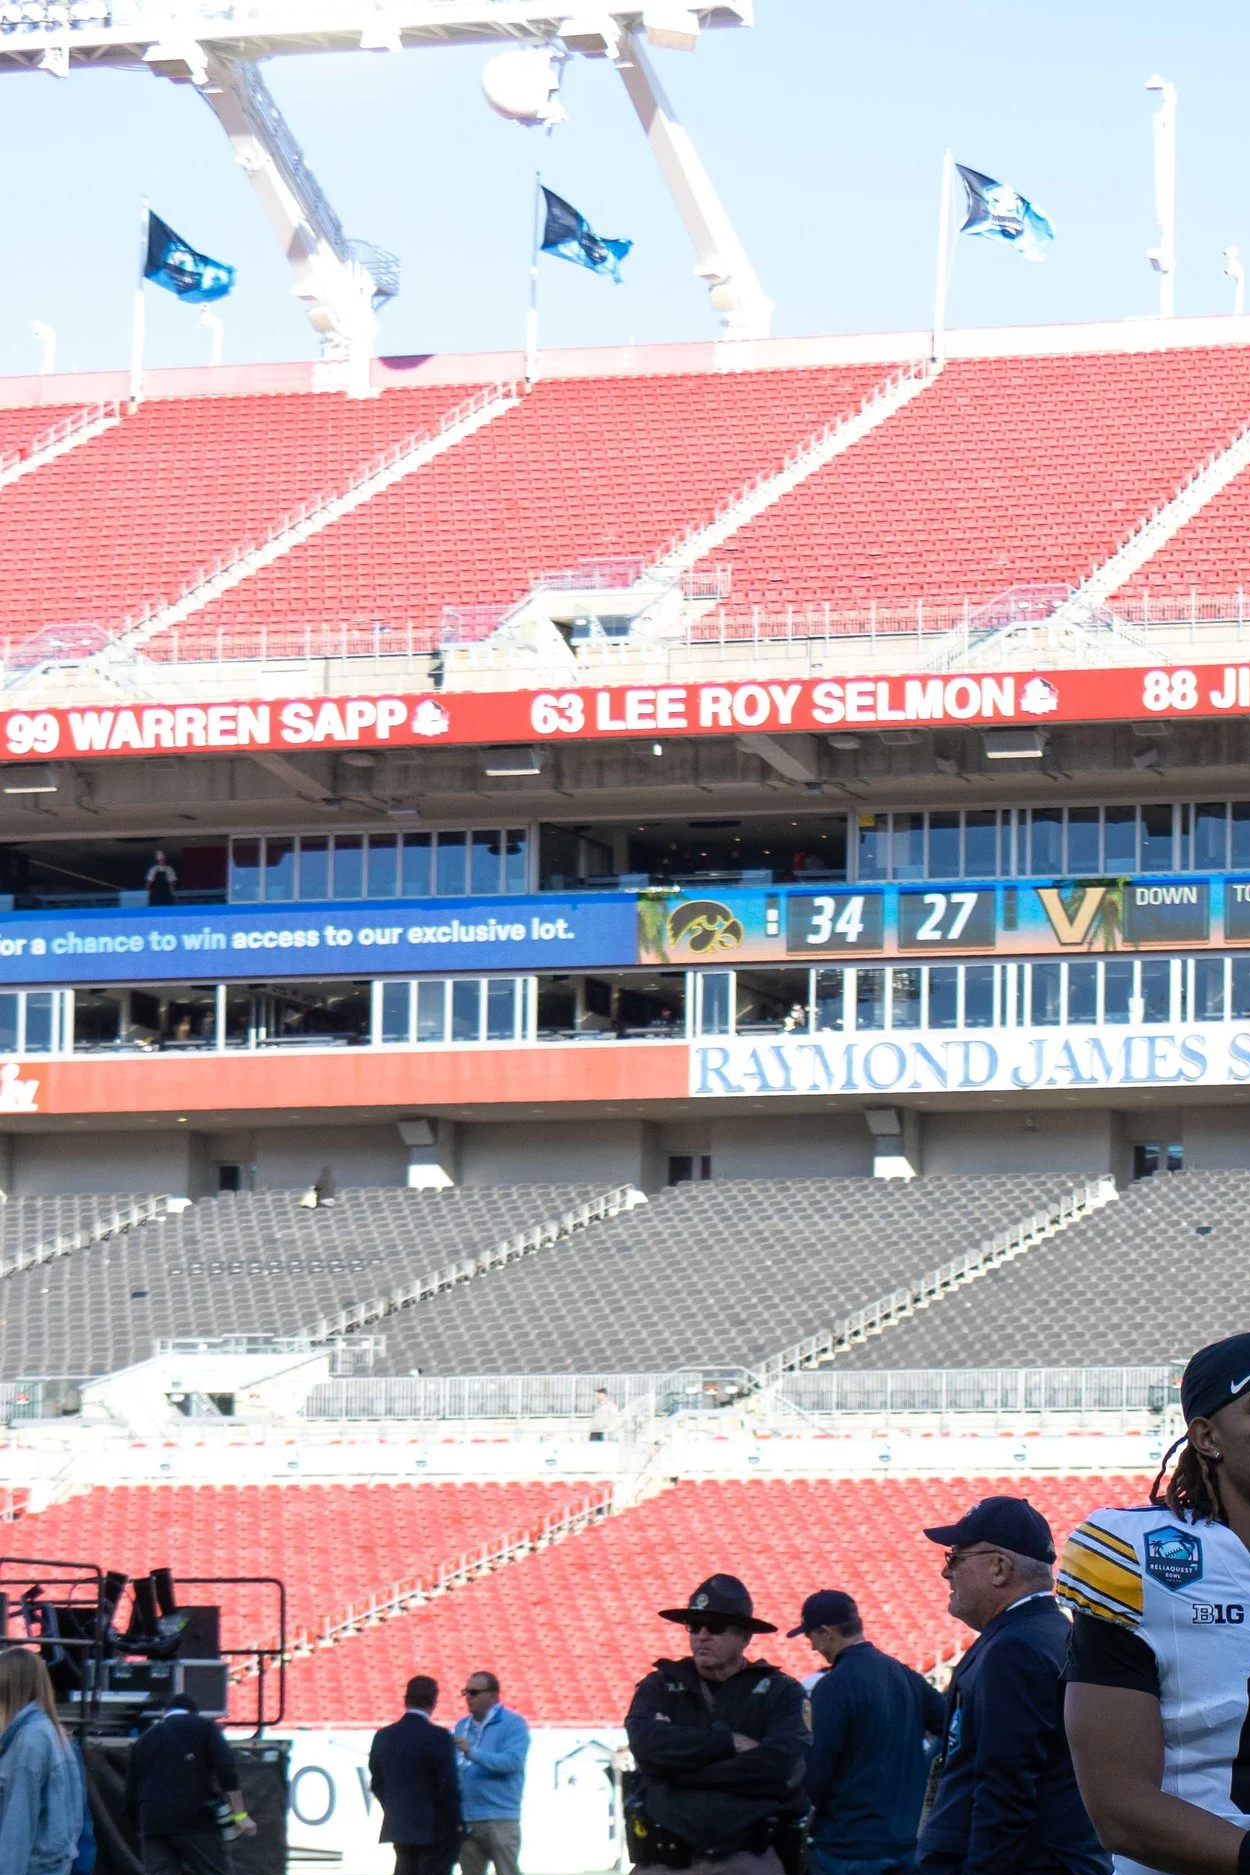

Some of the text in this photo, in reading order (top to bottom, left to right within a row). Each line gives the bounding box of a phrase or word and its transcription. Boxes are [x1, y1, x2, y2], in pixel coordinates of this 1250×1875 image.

[531, 677, 1015, 734] 63 LEE ROY SELMON
[1142, 670, 1198, 711] 88
[6, 699, 408, 755] 99 WARREN SAPP
[916, 893, 978, 941] 27
[1135, 887, 1198, 906] DOWN
[0, 917, 575, 956] or a chance to win access to our exclusive lot.
[806, 896, 865, 945] 34
[695, 1039, 999, 1093] RAYMOND
[1011, 1034, 1208, 1089] JAMES
[1150, 1563, 1193, 1574] RELIAQUEST
[1165, 1571, 1181, 1579] BOWL
